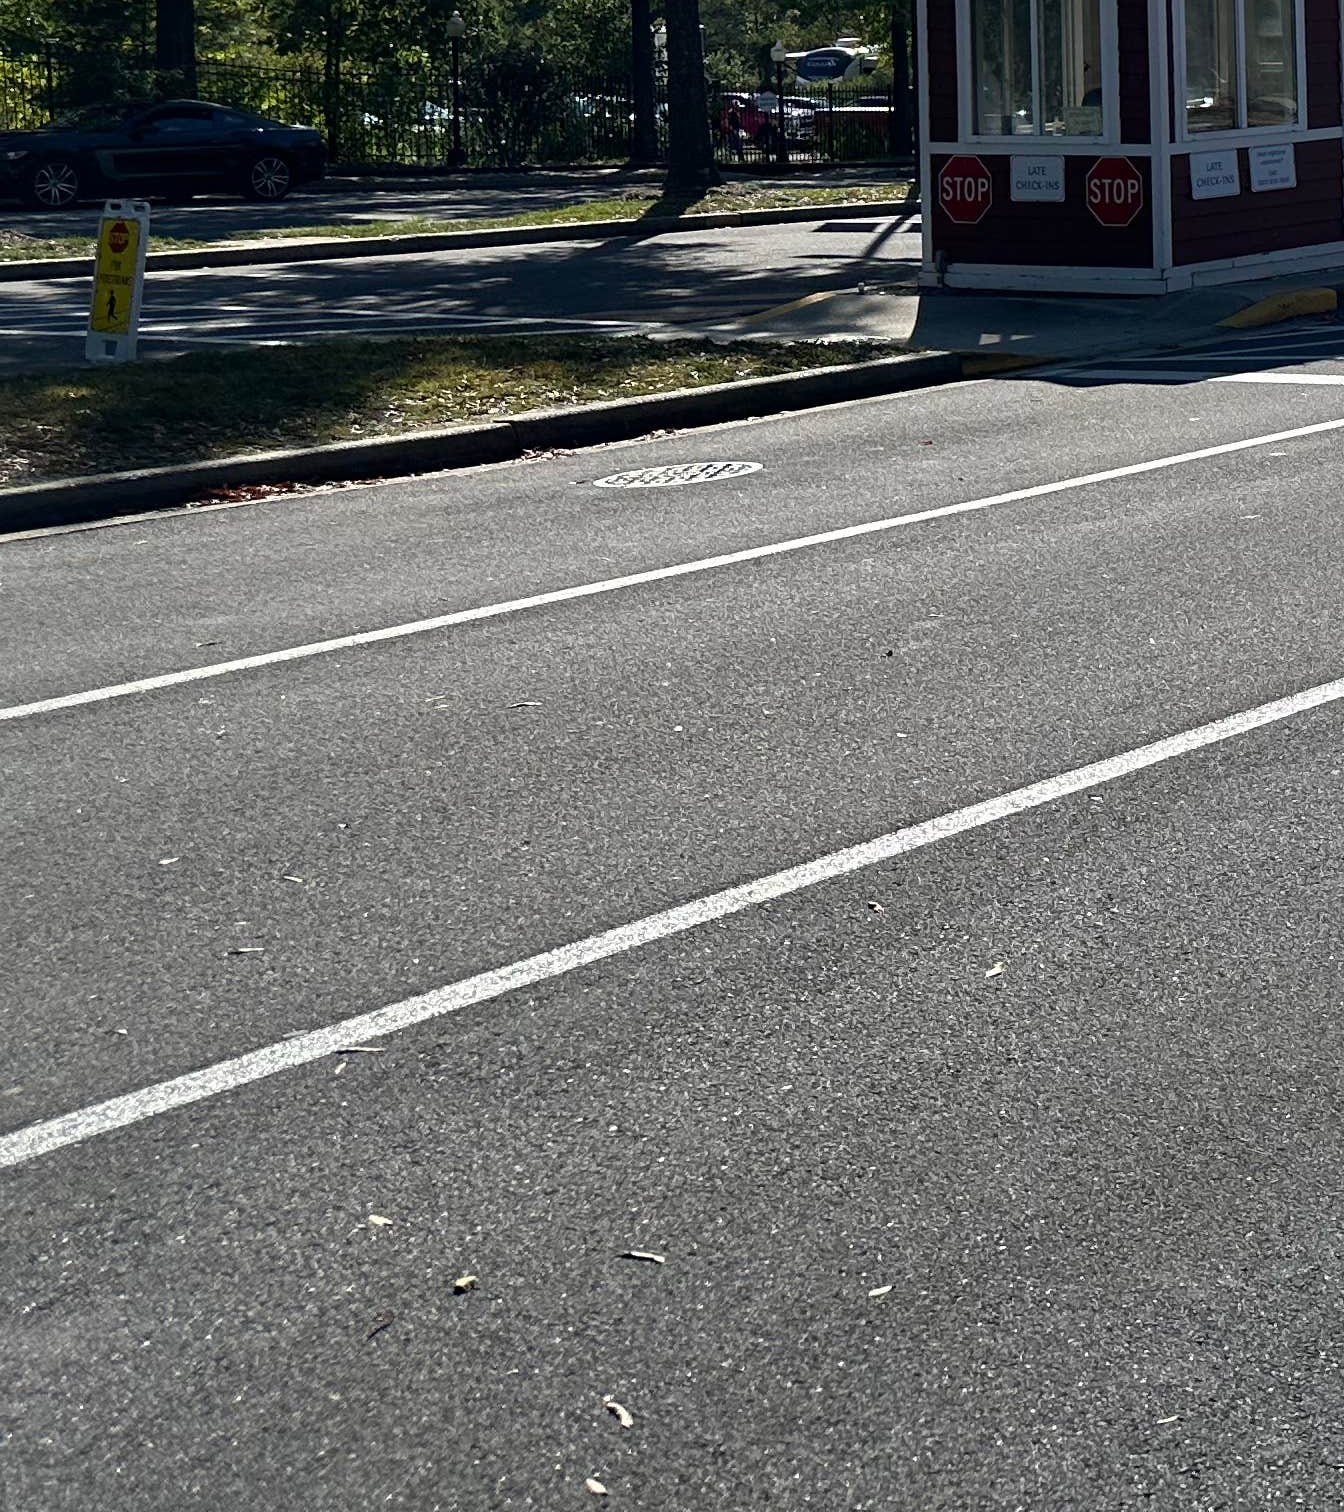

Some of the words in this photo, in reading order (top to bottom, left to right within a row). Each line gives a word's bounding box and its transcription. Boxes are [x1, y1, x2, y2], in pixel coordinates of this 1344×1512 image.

[1028, 166, 1047, 176] LATE
[1206, 161, 1224, 172] LATE
[1015, 180, 1061, 191] CHECK-INS
[1196, 174, 1235, 188] CHECK-INS
[942, 176, 989, 202] STOP
[1090, 178, 1139, 205] STOP
